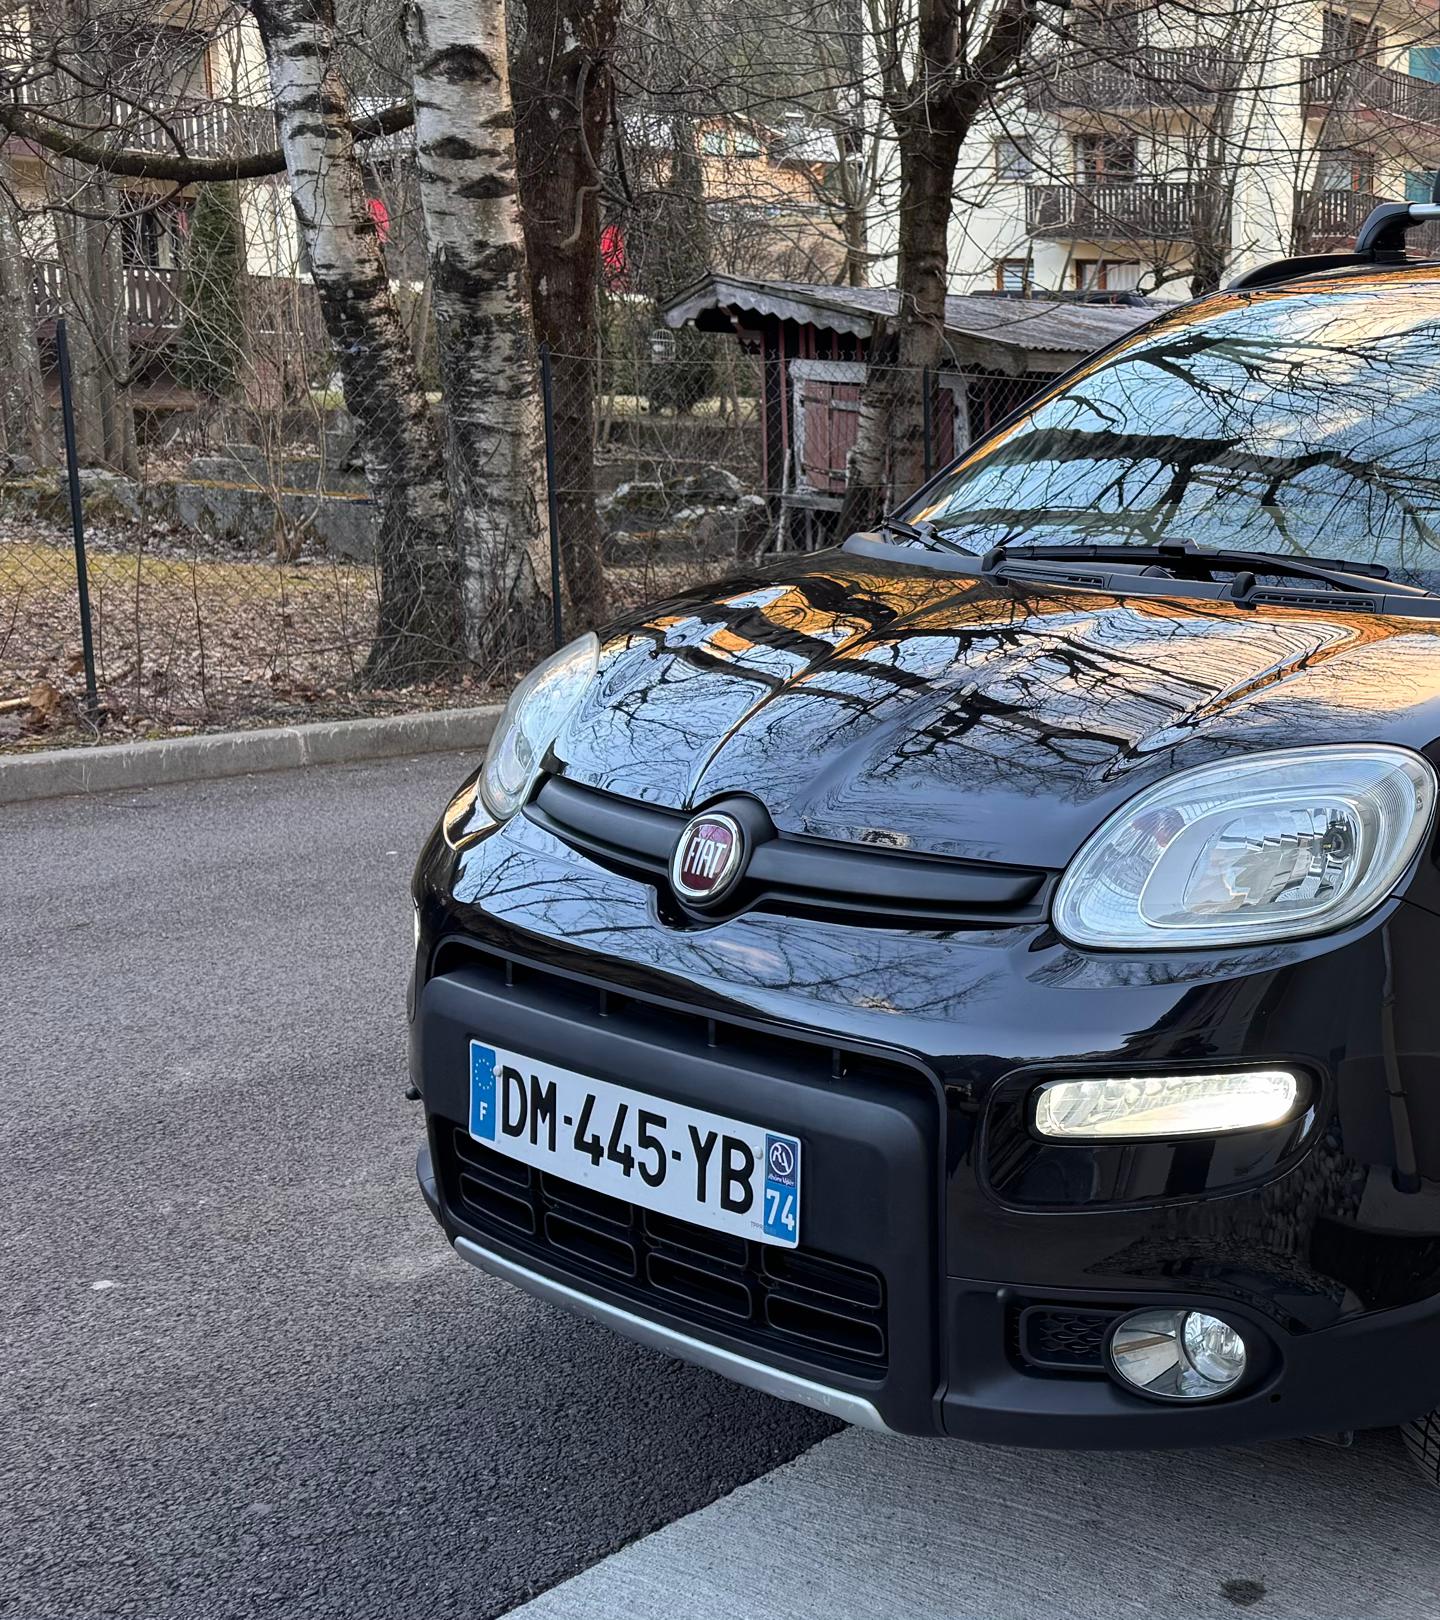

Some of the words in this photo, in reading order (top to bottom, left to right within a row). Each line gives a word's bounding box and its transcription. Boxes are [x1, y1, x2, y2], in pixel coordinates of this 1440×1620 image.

[683, 836, 728, 879] FIAT
[479, 1101, 488, 1121] F
[502, 1064, 755, 1215] DM-445-YB
[765, 1188, 795, 1232] 74
